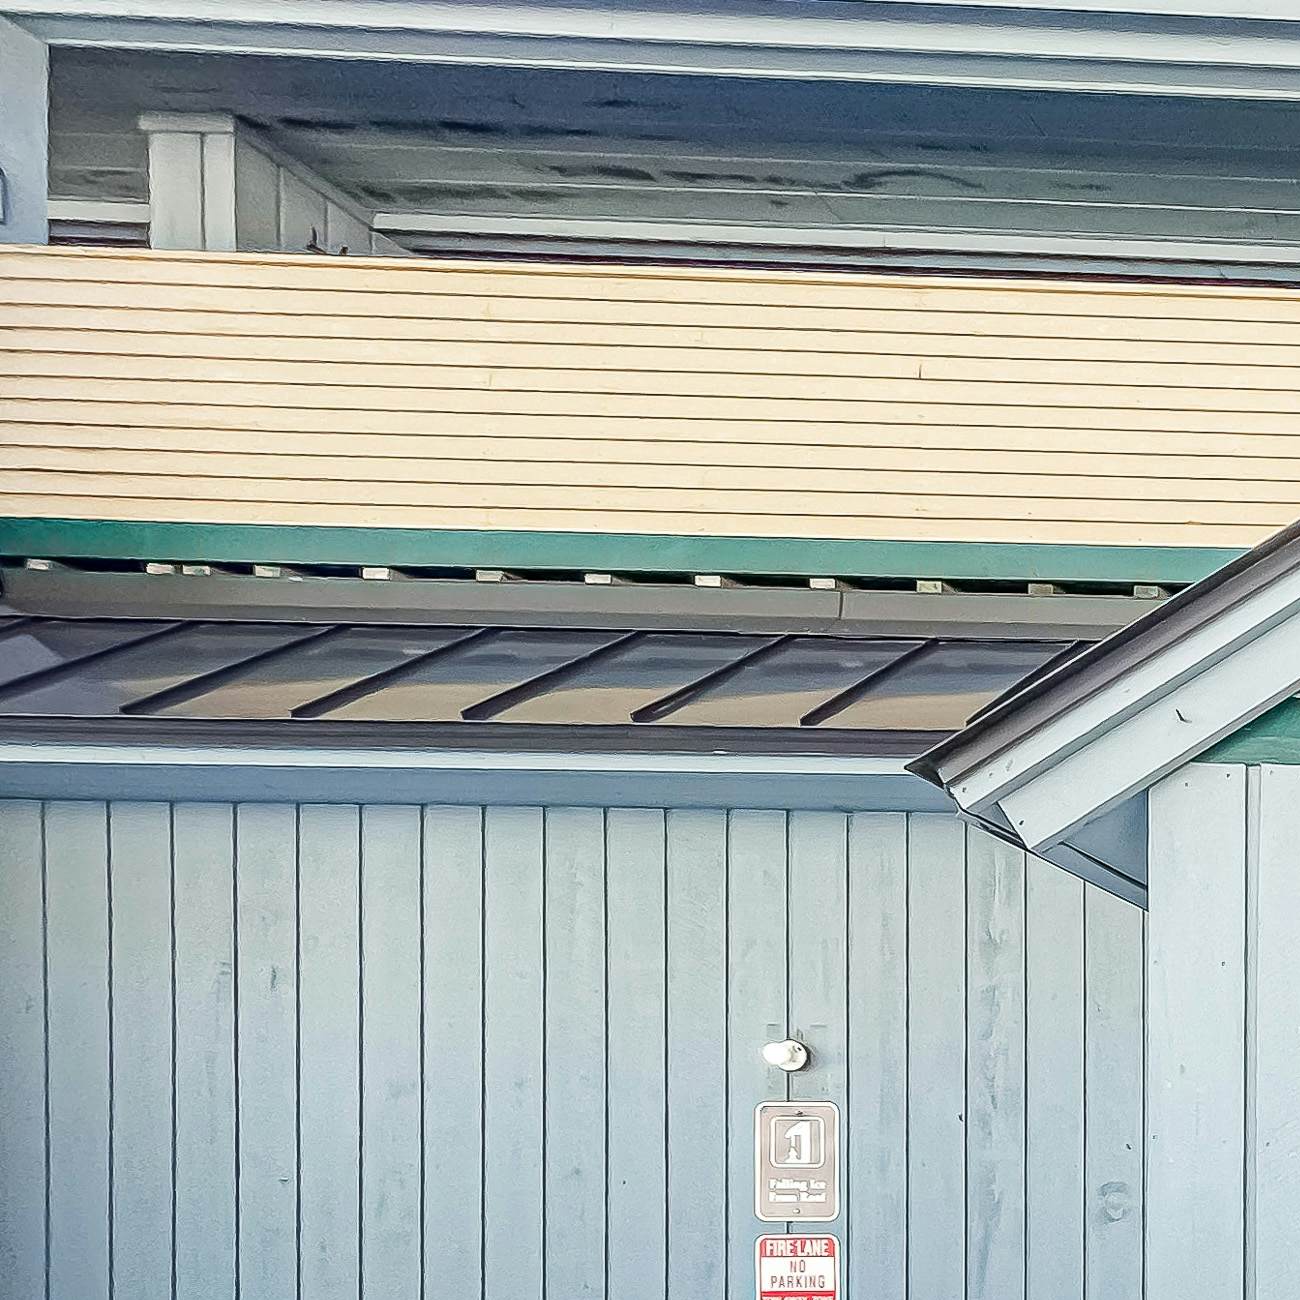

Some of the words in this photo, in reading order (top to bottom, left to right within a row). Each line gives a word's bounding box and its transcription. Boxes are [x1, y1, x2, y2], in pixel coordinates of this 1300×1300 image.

[765, 1239, 795, 1256] FIRE
[796, 1239, 830, 1256] LANE
[790, 1259, 806, 1273] NO
[770, 1275, 825, 1289] PARKING
